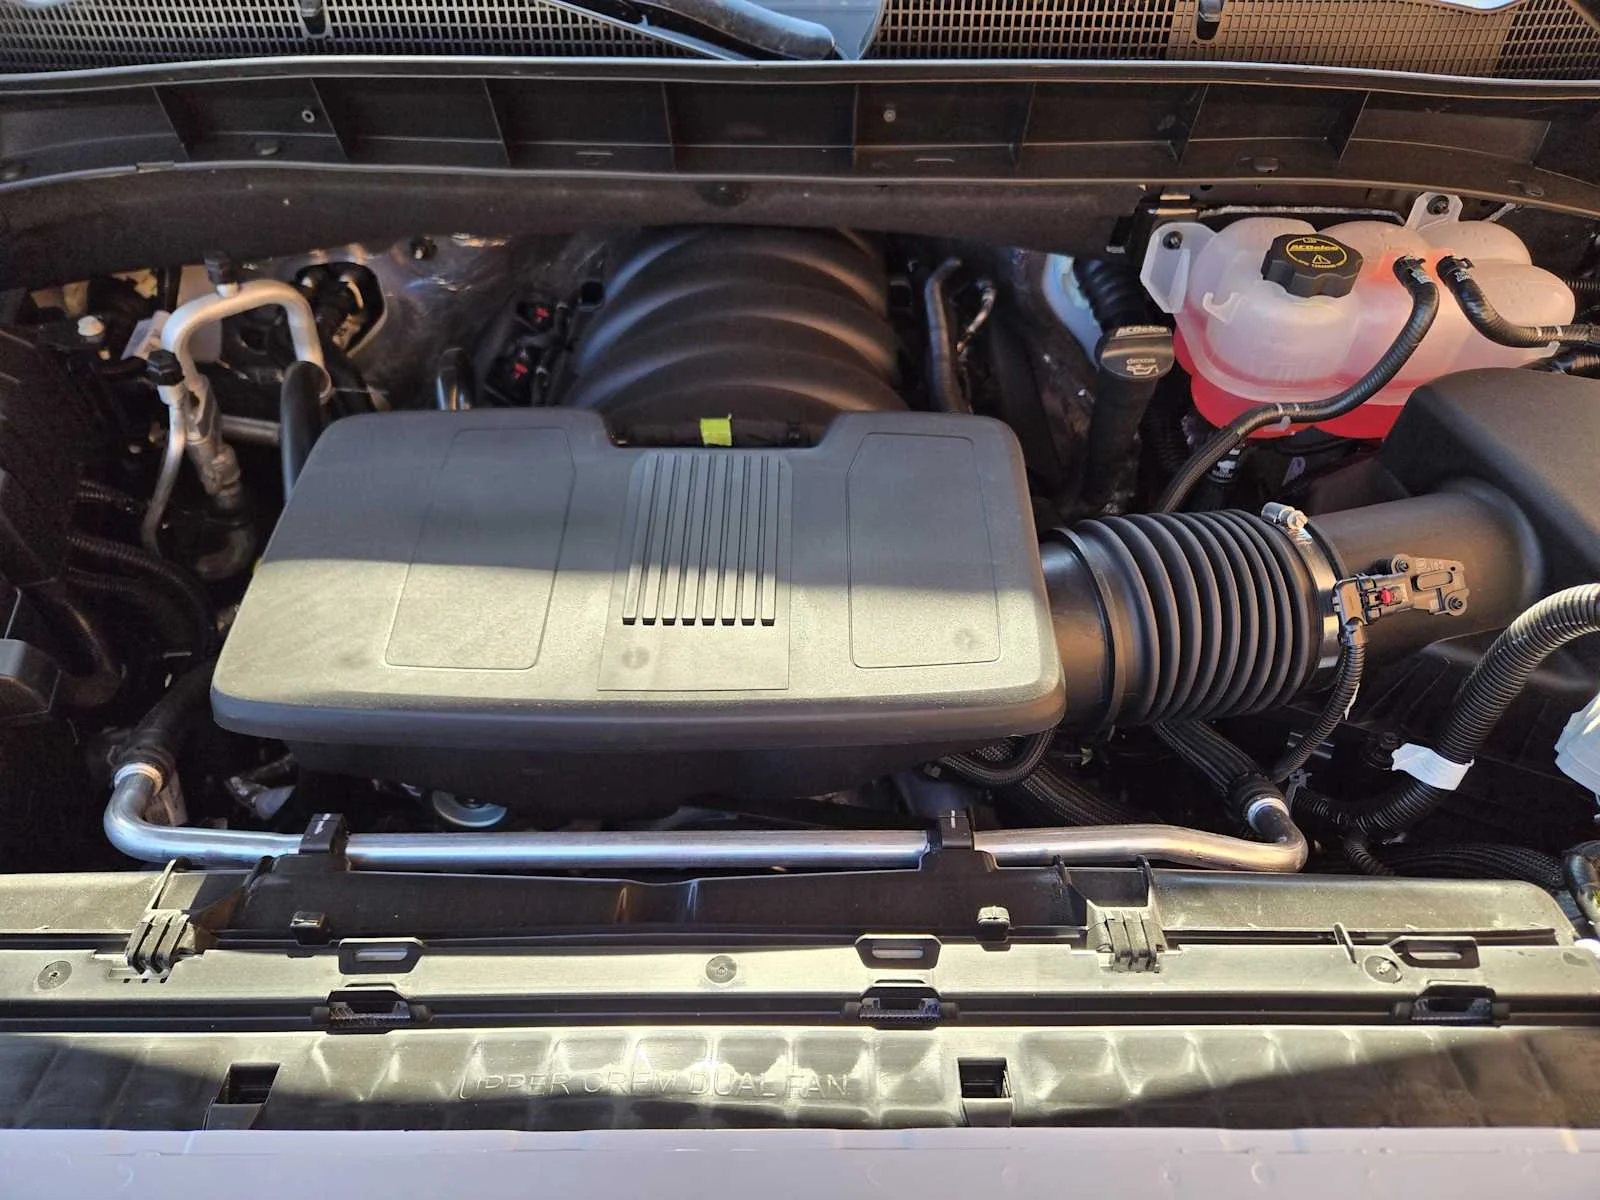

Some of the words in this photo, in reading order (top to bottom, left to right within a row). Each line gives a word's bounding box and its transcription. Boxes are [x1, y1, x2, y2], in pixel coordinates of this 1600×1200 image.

[459, 1073, 571, 1099] UPPER
[688, 1071, 777, 1097] DUAL
[784, 1074, 848, 1098] FAN
